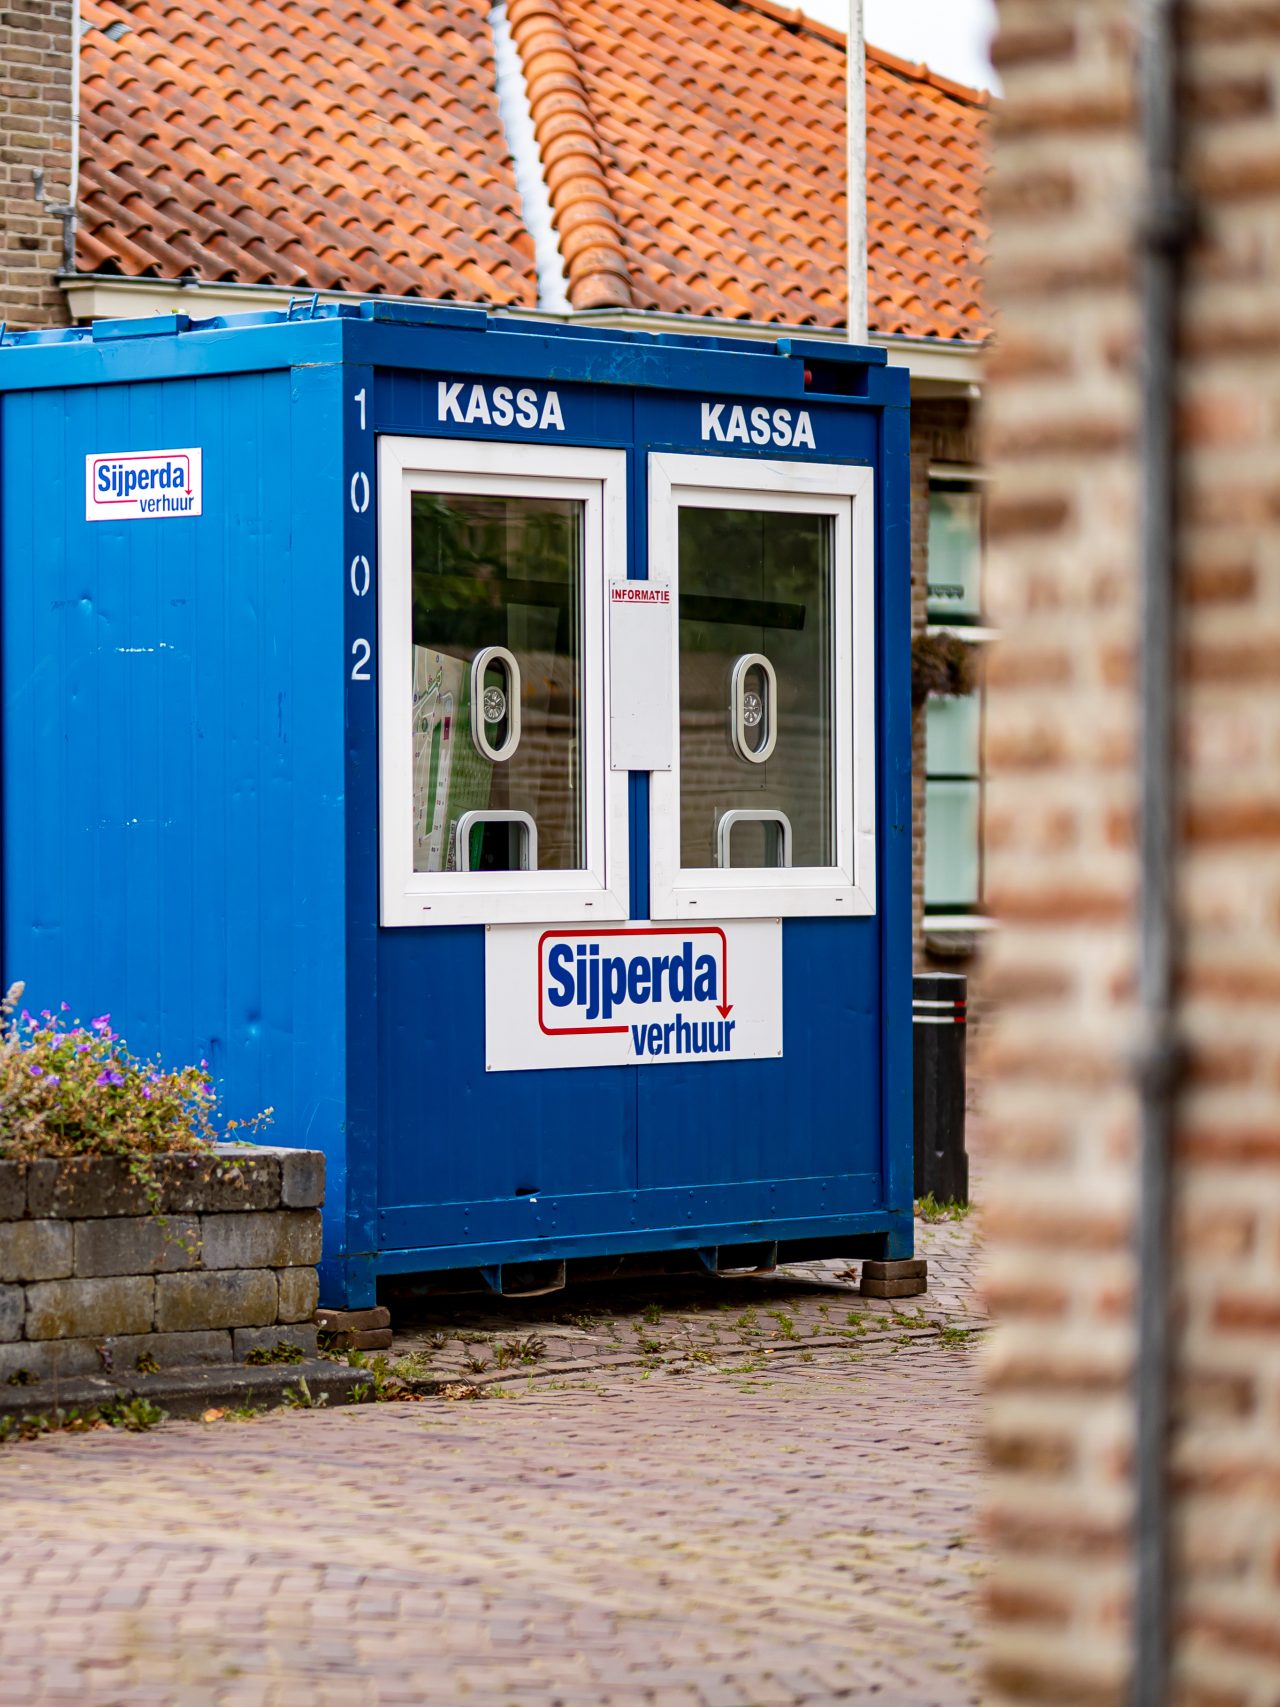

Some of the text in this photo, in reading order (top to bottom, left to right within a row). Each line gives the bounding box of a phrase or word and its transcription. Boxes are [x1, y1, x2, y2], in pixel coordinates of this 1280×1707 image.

[437, 381, 565, 430] KASSA
[700, 402, 816, 449] KASSA
[98, 462, 184, 497] Sijperda
[139, 495, 194, 512] verhuur
[612, 589, 670, 601] INFORMATIE
[548, 941, 717, 1020] Sijperda
[631, 1013, 735, 1056] verhuur
